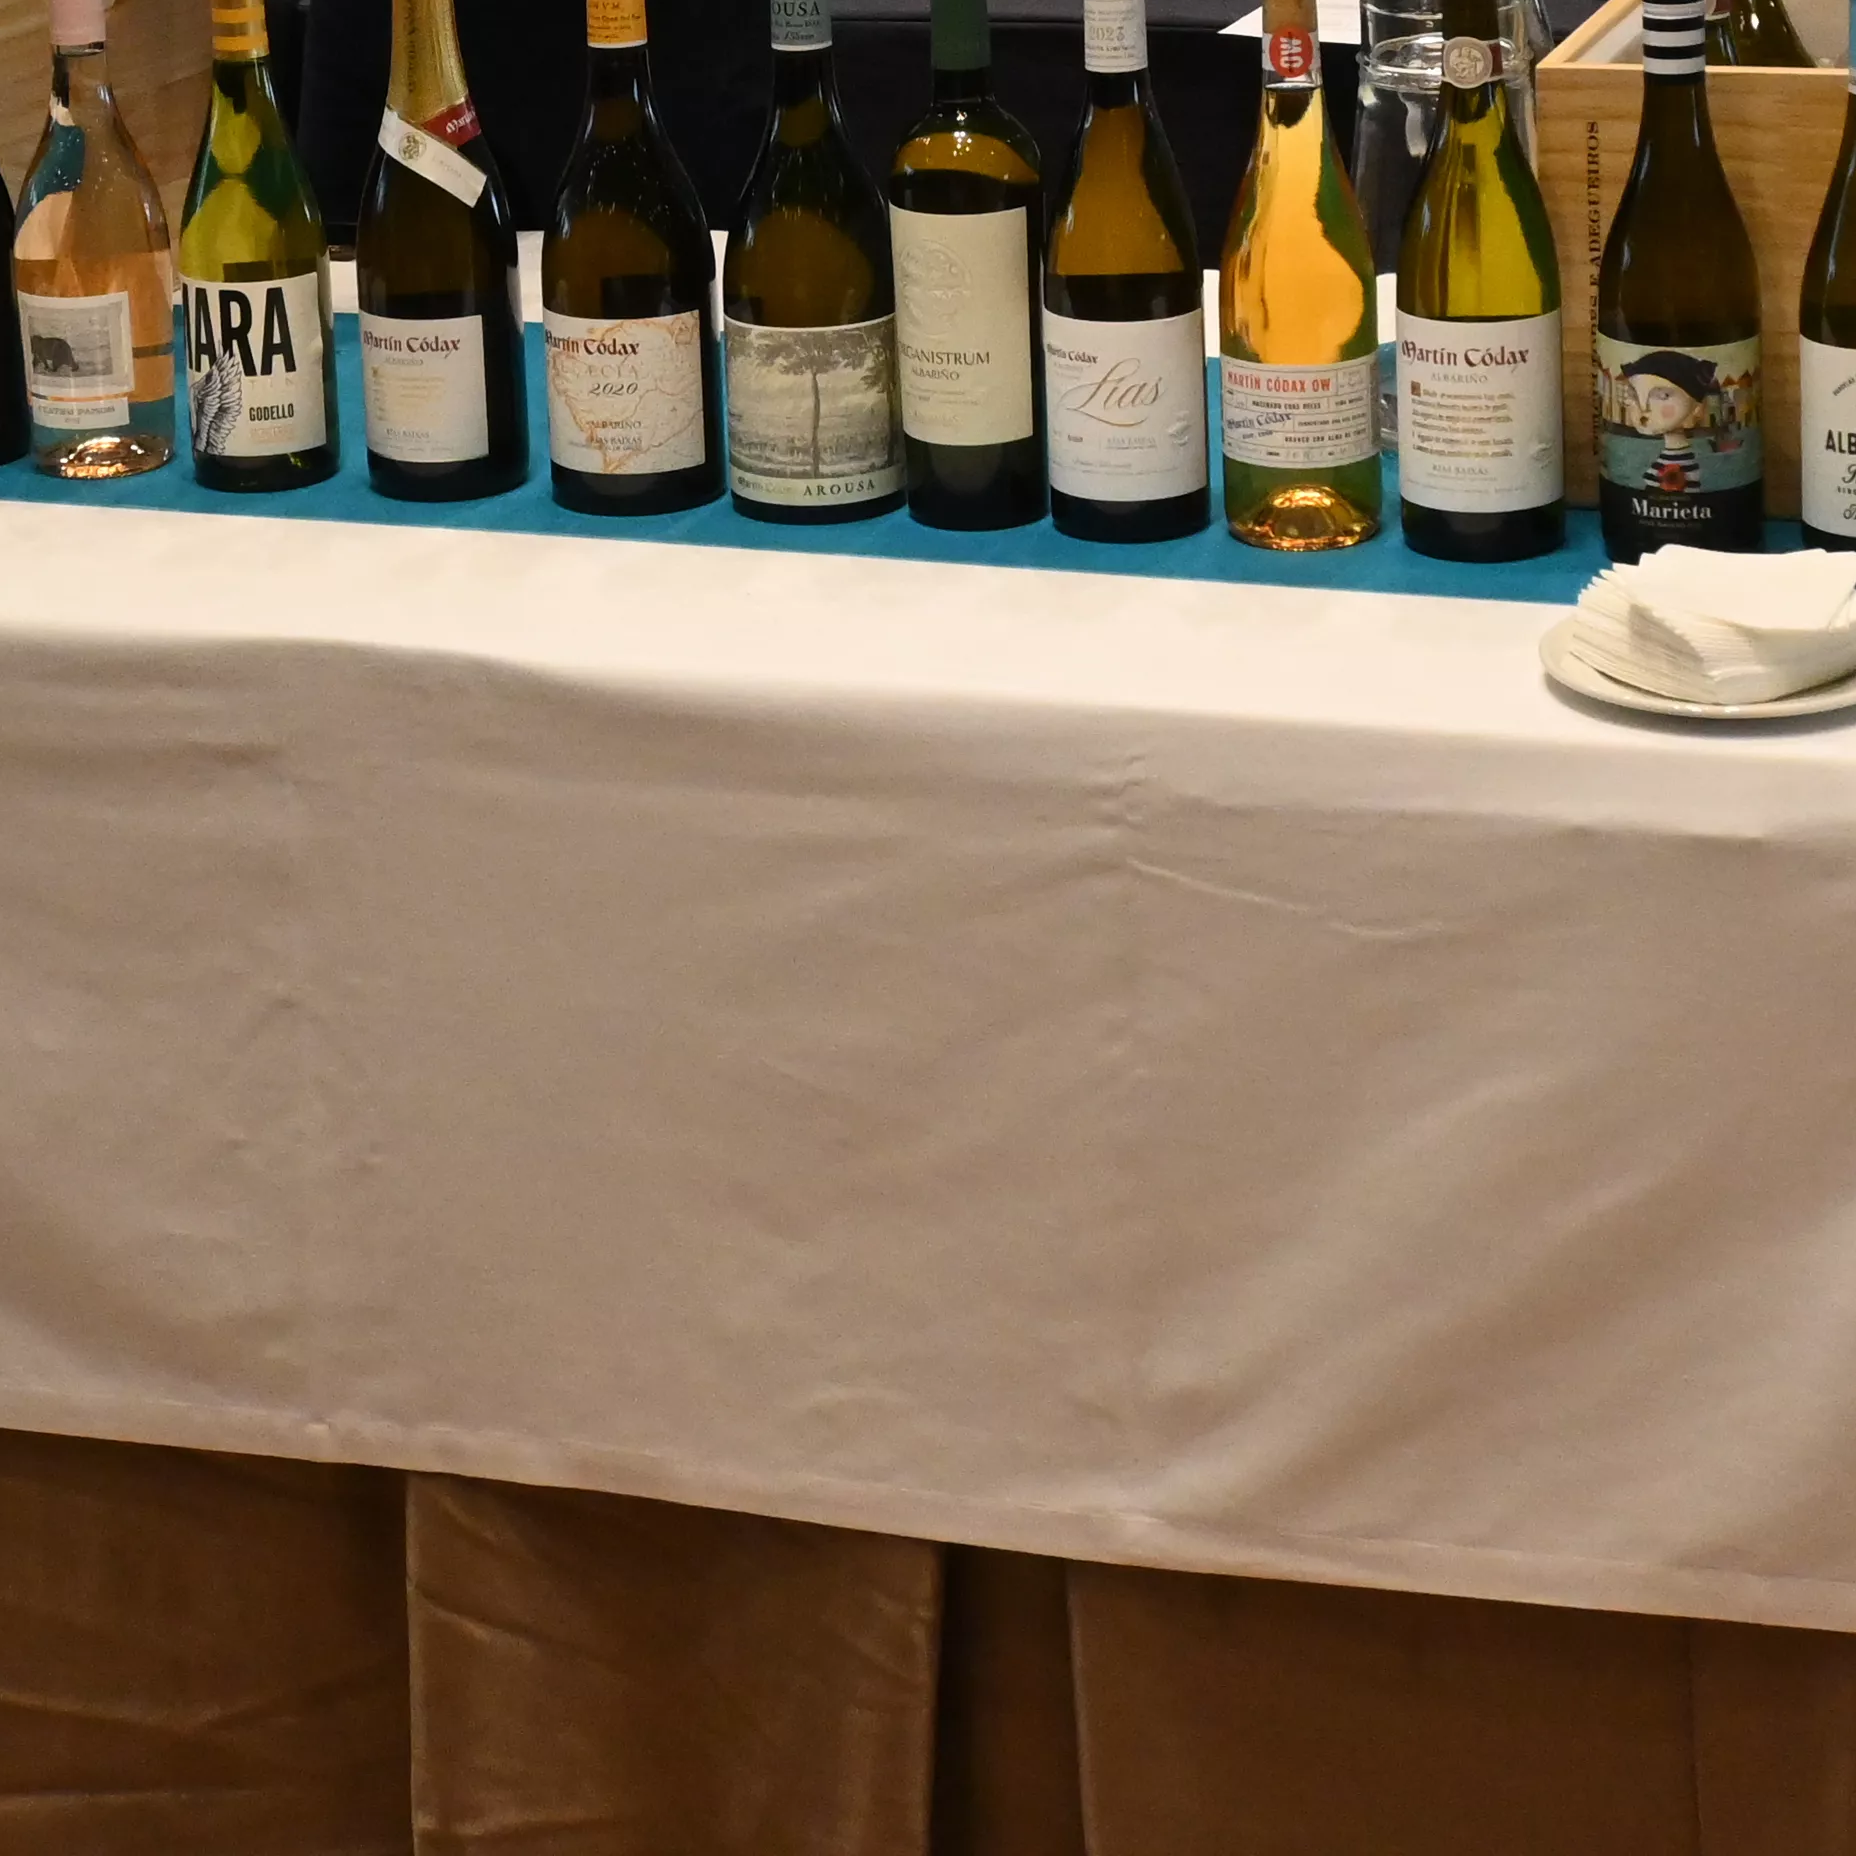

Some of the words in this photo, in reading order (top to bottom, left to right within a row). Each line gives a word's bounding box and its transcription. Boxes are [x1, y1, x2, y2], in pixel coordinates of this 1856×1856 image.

[772, 0, 821, 17] OUSA
[1279, 36, 1304, 69] OW
[1586, 120, 1602, 267] ADEGUEIROS
[363, 330, 403, 353] Martín
[406, 335, 461, 360] Códax
[583, 338, 641, 365] Códax
[1401, 339, 1458, 366] Martín
[1464, 346, 1530, 374] Códax
[911, 366, 960, 382] ALBARIÑO
[1228, 370, 1262, 391] MARTÍN
[1266, 375, 1307, 394] CÓDAX
[1311, 377, 1332, 393] OW
[1431, 372, 1489, 384] ALBARIÑO
[589, 381, 639, 396] 2020
[249, 403, 295, 422] GODELLO
[804, 479, 876, 497] AROUSA
[1632, 497, 1713, 520] Marieta
